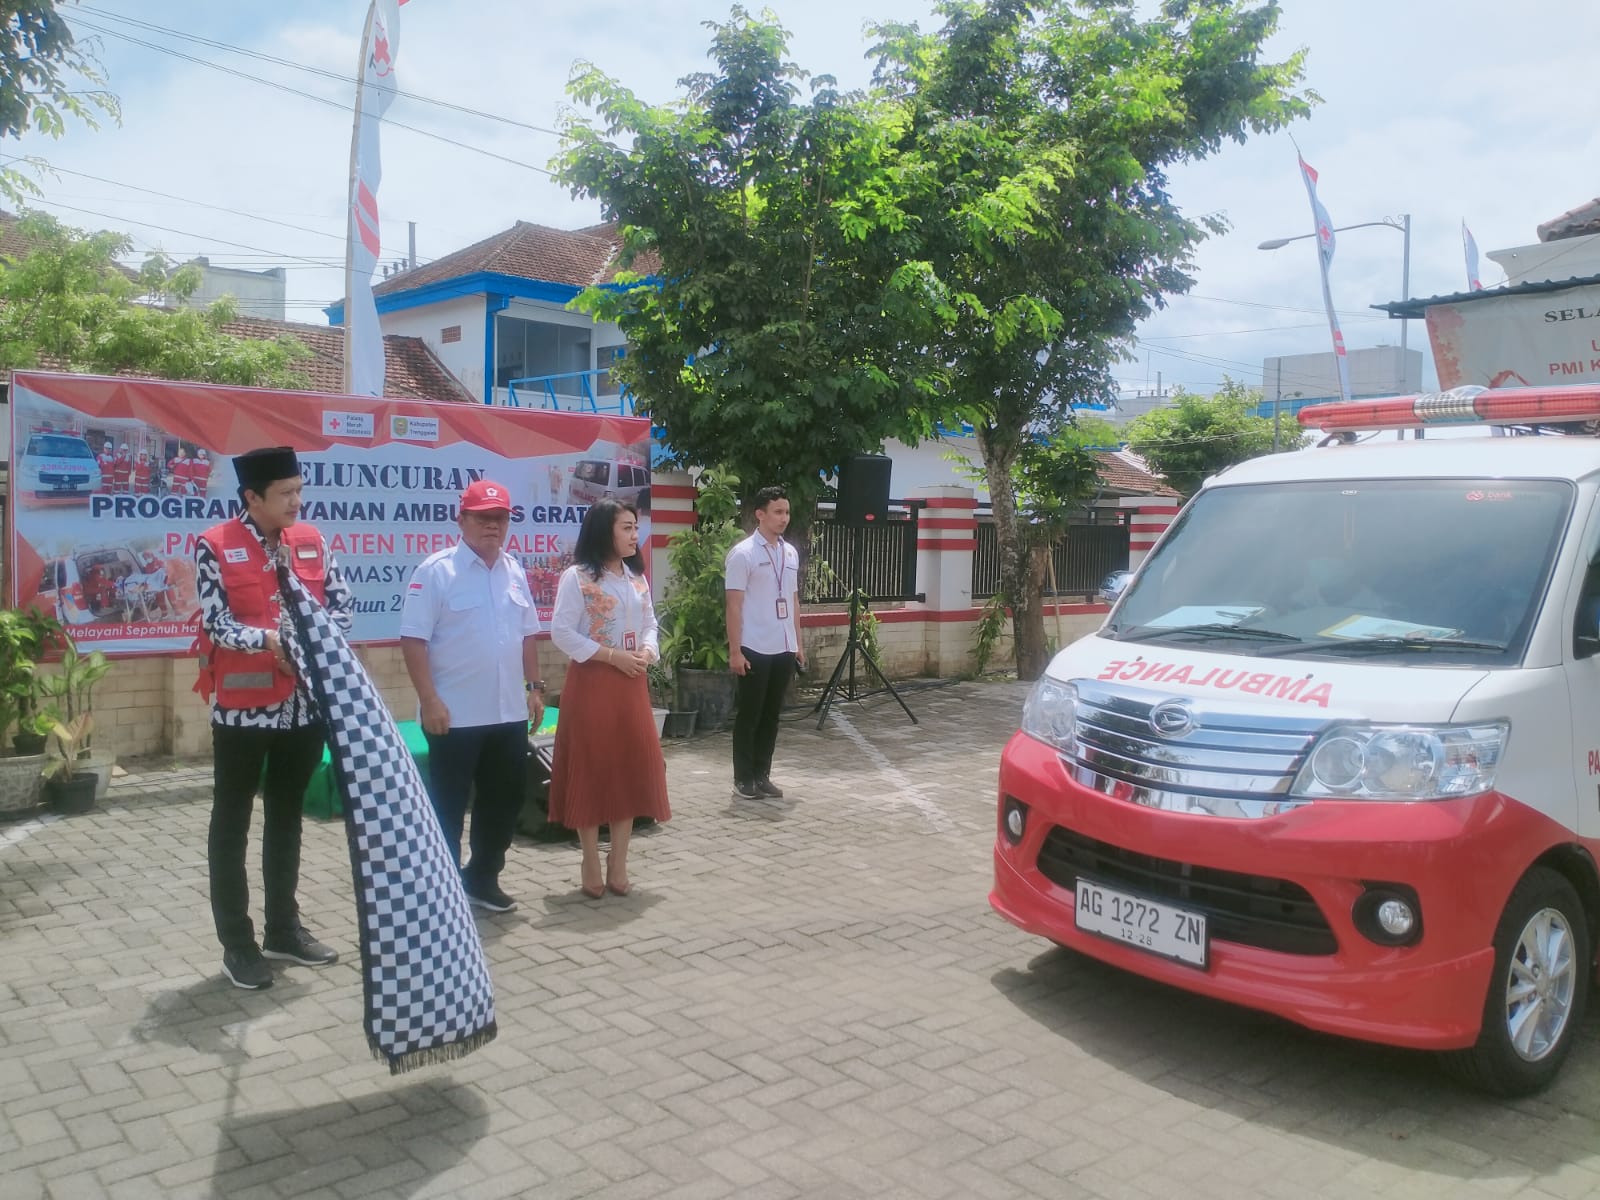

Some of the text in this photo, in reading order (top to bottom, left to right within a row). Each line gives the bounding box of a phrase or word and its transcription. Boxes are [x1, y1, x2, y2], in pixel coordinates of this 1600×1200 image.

[1549, 359, 1600, 375] PMI K
[299, 462, 485, 490] ELUNCURAN
[299, 501, 385, 521] YANAN
[532, 505, 592, 524] GRAT
[66, 625, 123, 639] Melayani
[126, 624, 178, 636] Sepenuh
[1588, 749, 1600, 776] PA
[1080, 887, 1201, 946] AG 1272 ZN
